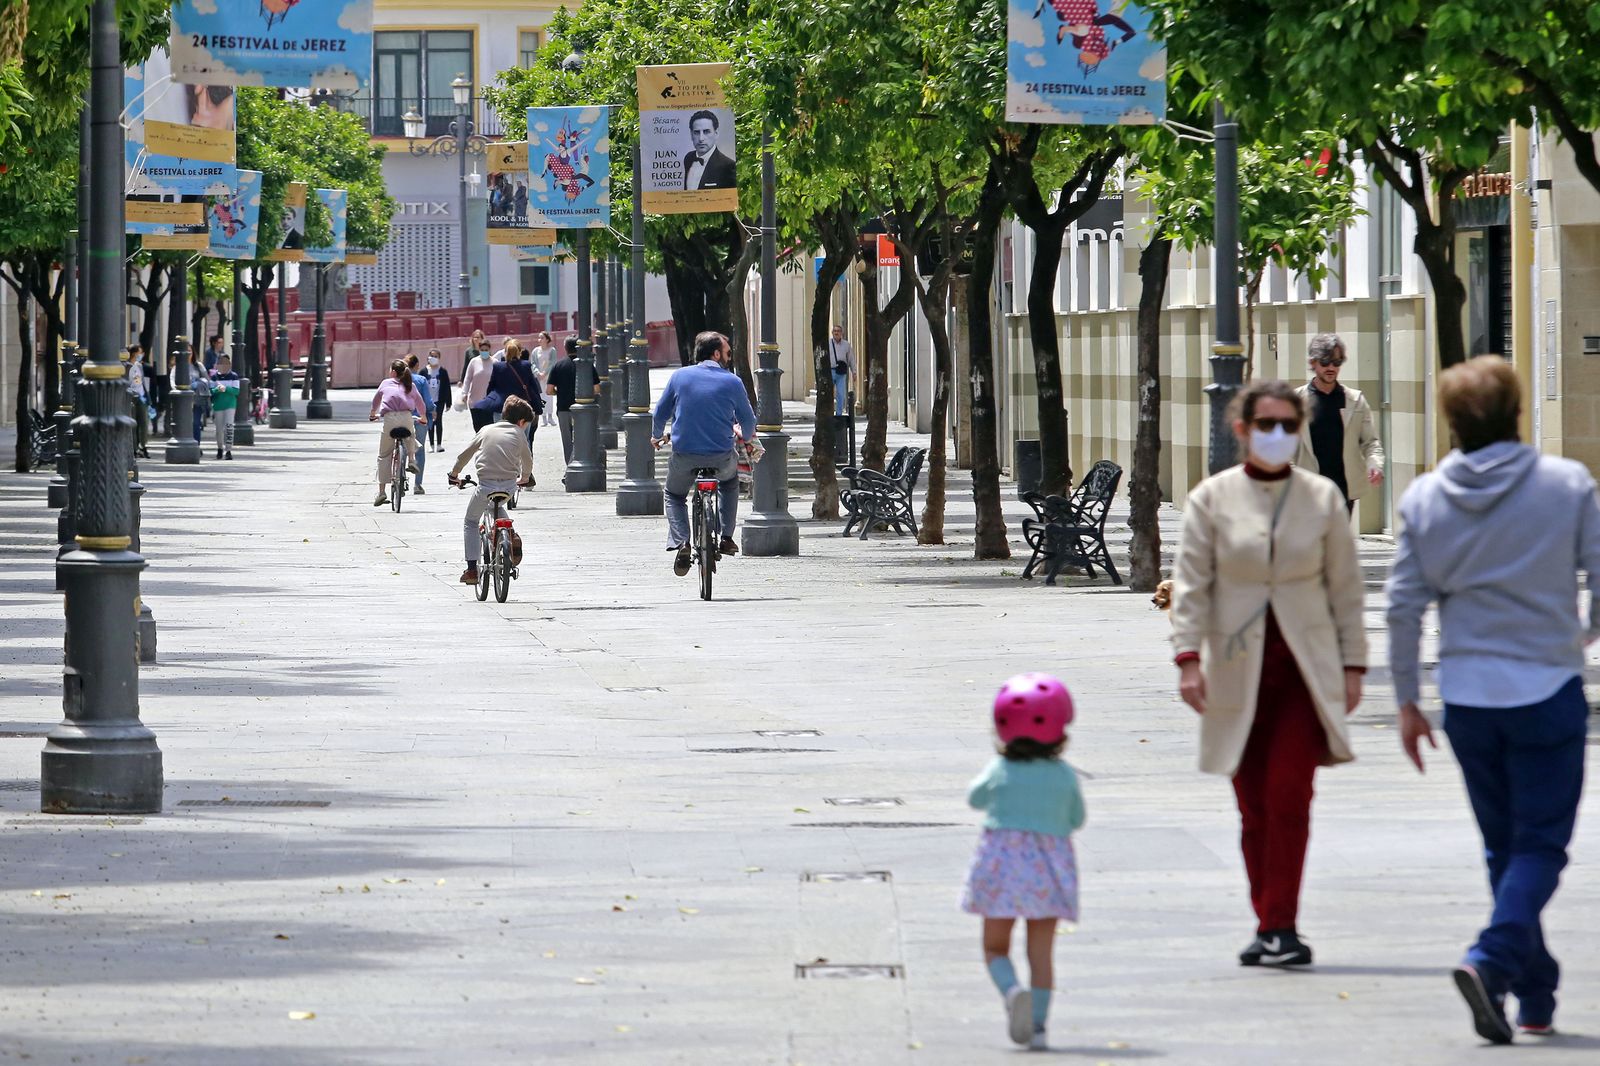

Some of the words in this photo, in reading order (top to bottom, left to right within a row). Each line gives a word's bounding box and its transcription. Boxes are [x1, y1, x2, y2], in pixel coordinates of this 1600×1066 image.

[192, 35, 208, 48] 24
[211, 35, 279, 50] FESTIVAL
[282, 40, 297, 51] DE
[301, 39, 347, 52] JEREZ
[1025, 83, 1039, 93] 24
[1042, 83, 1094, 96] FESTIVAL
[1097, 87, 1109, 96] DE
[1111, 86, 1147, 97] JEREZ
[652, 116, 680, 124] Bésame
[655, 150, 678, 159] JUAN
[652, 161, 681, 169] DIEGO
[138, 168, 148, 176] 24
[149, 168, 187, 177] FESTIVAL
[198, 168, 223, 176] JEREZ
[651, 170, 683, 180] FLÓREZ
[546, 208, 574, 216] FESTIVAL
[582, 207, 601, 215] JEREZ
